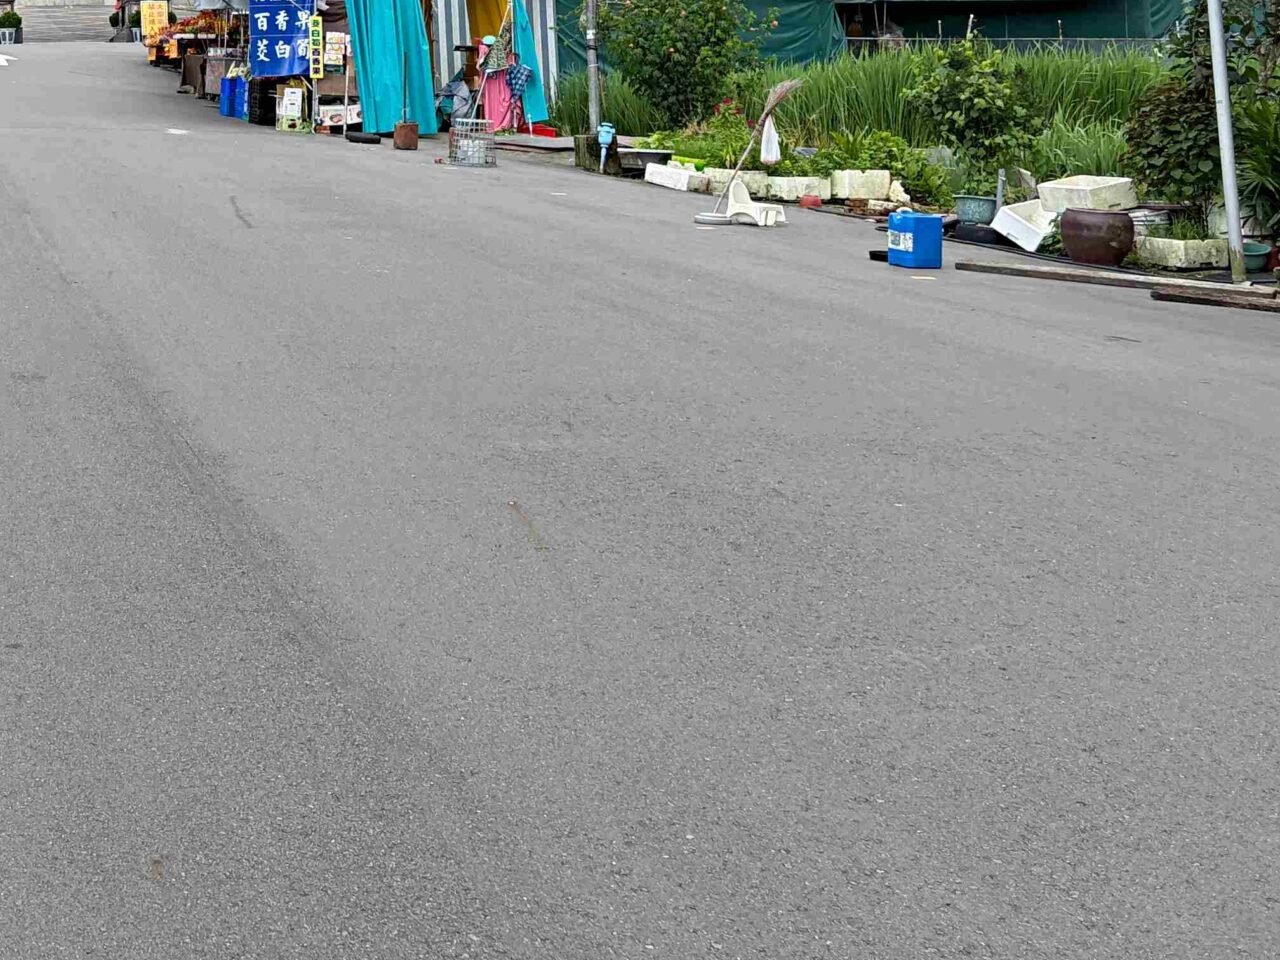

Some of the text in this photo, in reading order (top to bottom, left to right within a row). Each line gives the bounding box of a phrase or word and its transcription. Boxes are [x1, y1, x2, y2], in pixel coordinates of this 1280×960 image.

[254, 10, 311, 31] 百香果
[256, 39, 311, 61] 茭白筍
